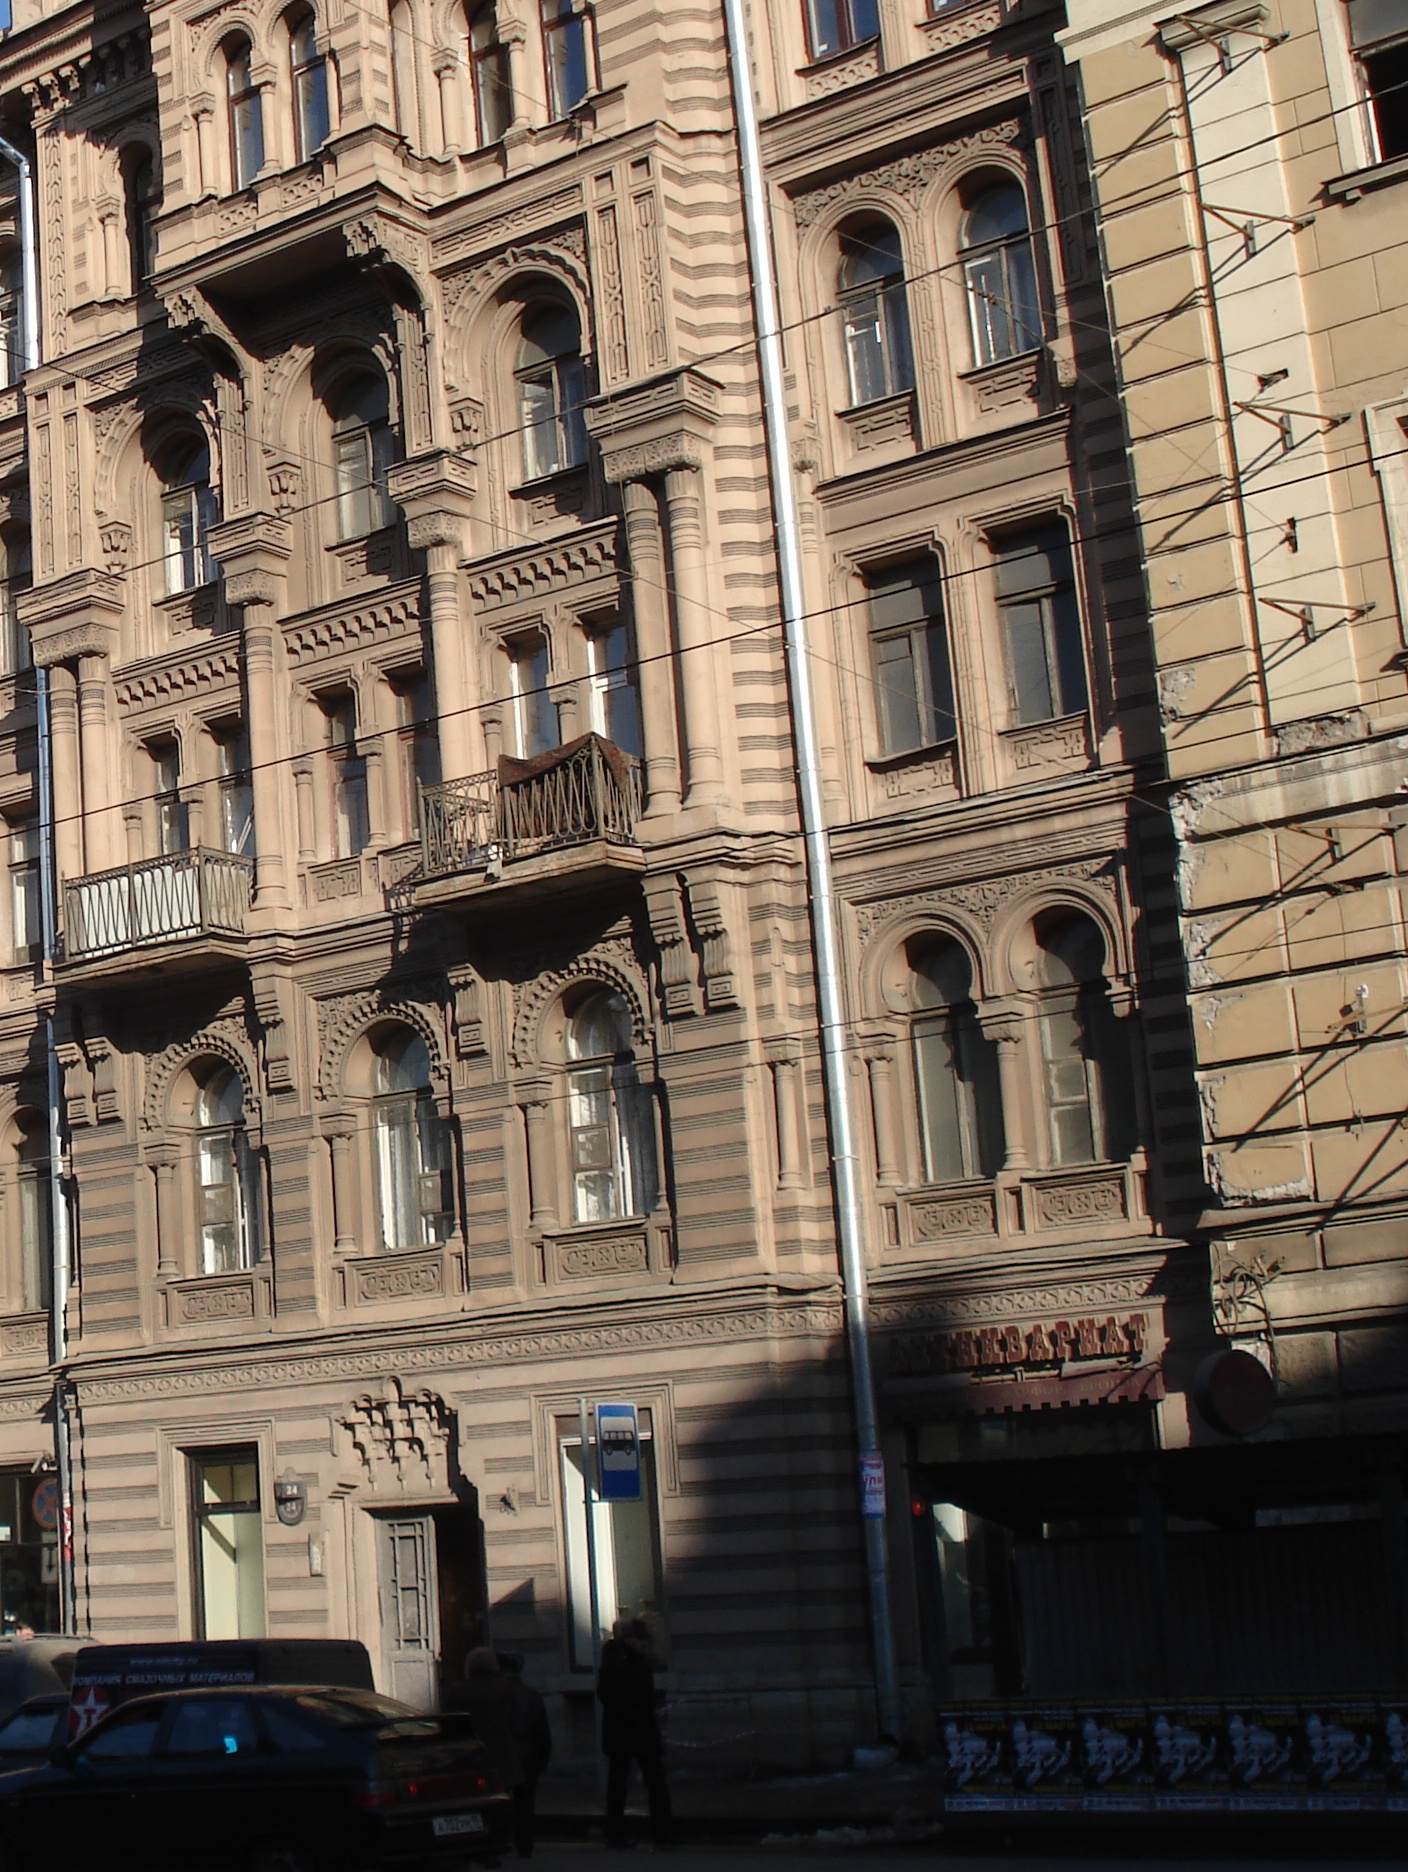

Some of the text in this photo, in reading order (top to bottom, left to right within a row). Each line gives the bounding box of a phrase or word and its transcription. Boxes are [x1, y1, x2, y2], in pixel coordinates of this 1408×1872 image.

[888, 1313, 1146, 1374] АНТИКВАРИАТ
[286, 1485, 298, 1495] 24
[125, 1672, 186, 1685] СМАЗОЧНЫХ
[189, 1671, 255, 1683] МАТЕРИАЛОВ
